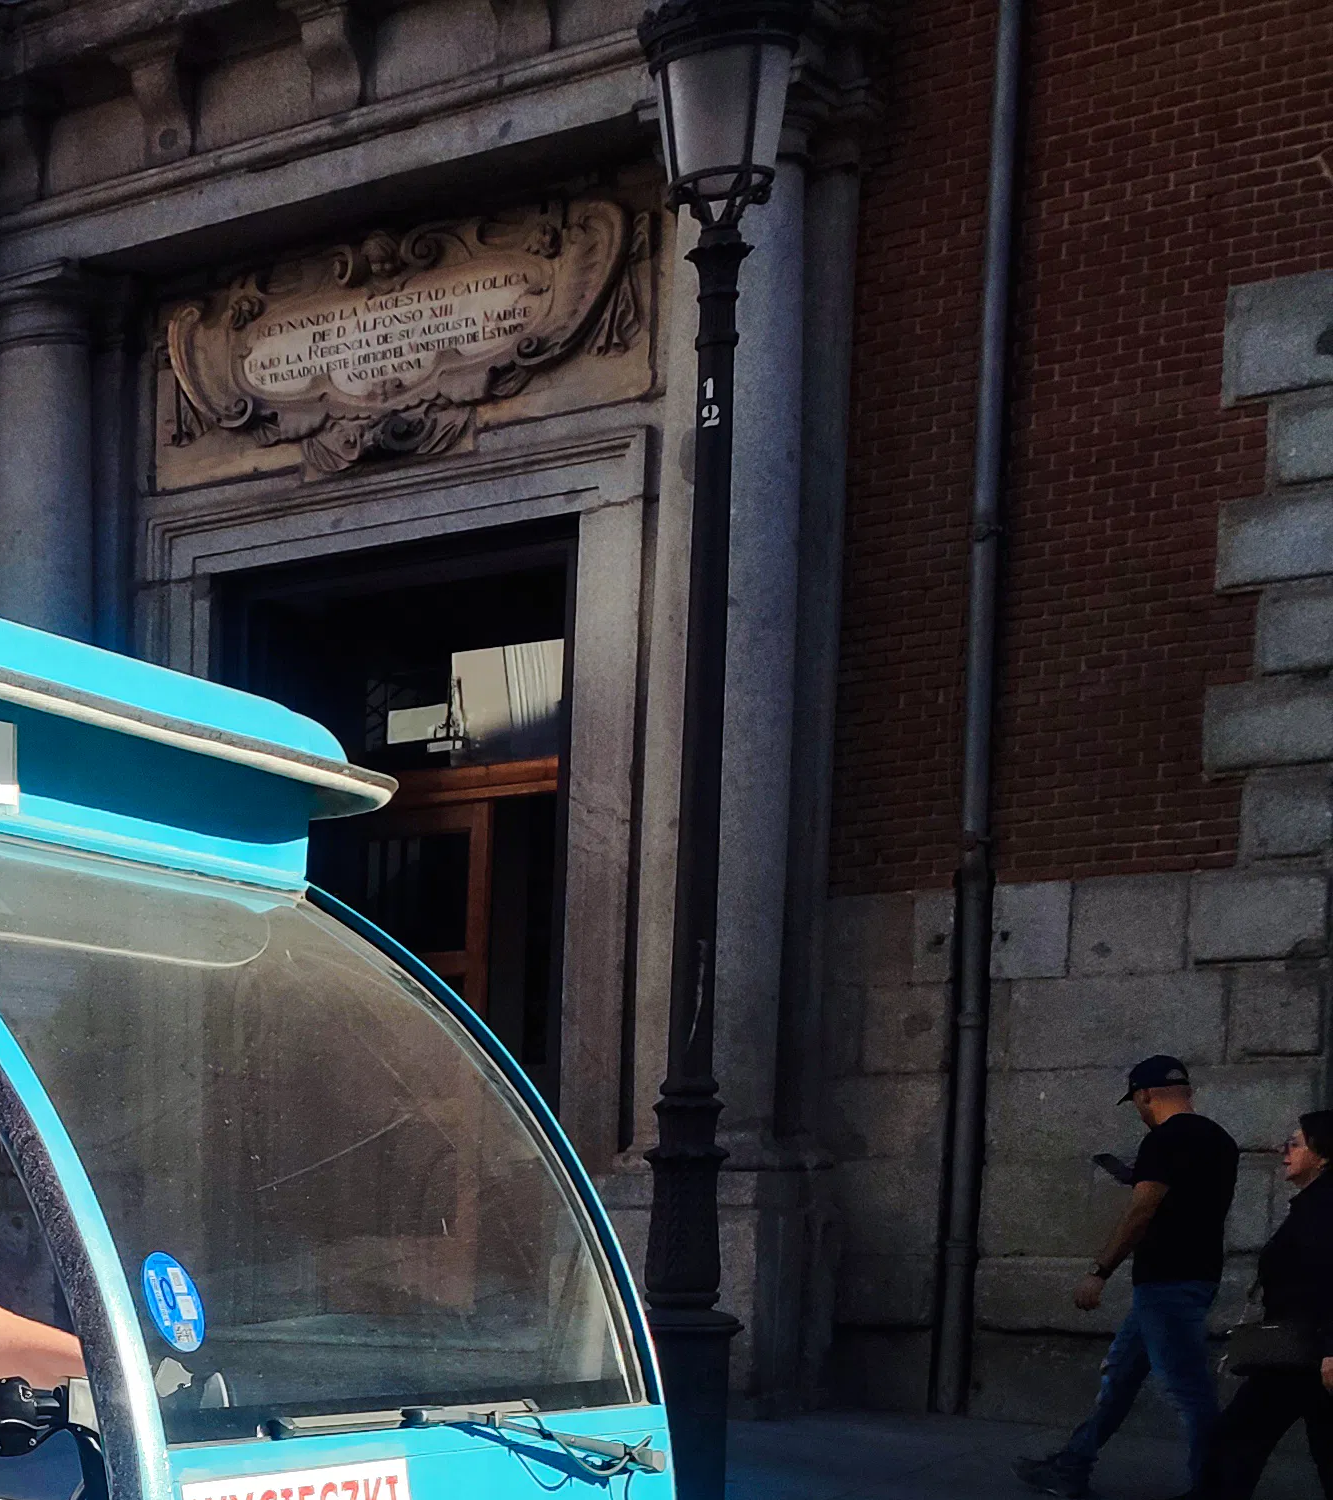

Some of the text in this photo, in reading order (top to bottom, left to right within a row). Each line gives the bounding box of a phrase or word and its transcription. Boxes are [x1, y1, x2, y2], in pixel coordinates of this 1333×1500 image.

[257, 311, 336, 340] REYNANDO
[339, 307, 358, 321] LA
[452, 272, 530, 297] CATOLICA
[312, 329, 332, 343] DE
[354, 309, 423, 333] ALFONSO
[429, 303, 453, 318] XIII
[249, 356, 281, 373] BAJO
[286, 353, 303, 365] LA
[308, 338, 371, 360] REGENCIA
[376, 334, 393, 346] DE
[398, 329, 415, 341] SU
[420, 317, 477, 337] AUGUSTA
[269, 365, 317, 384] TRASLADO
[466, 331, 480, 344] DE
[482, 323, 524, 340] ESTADO
